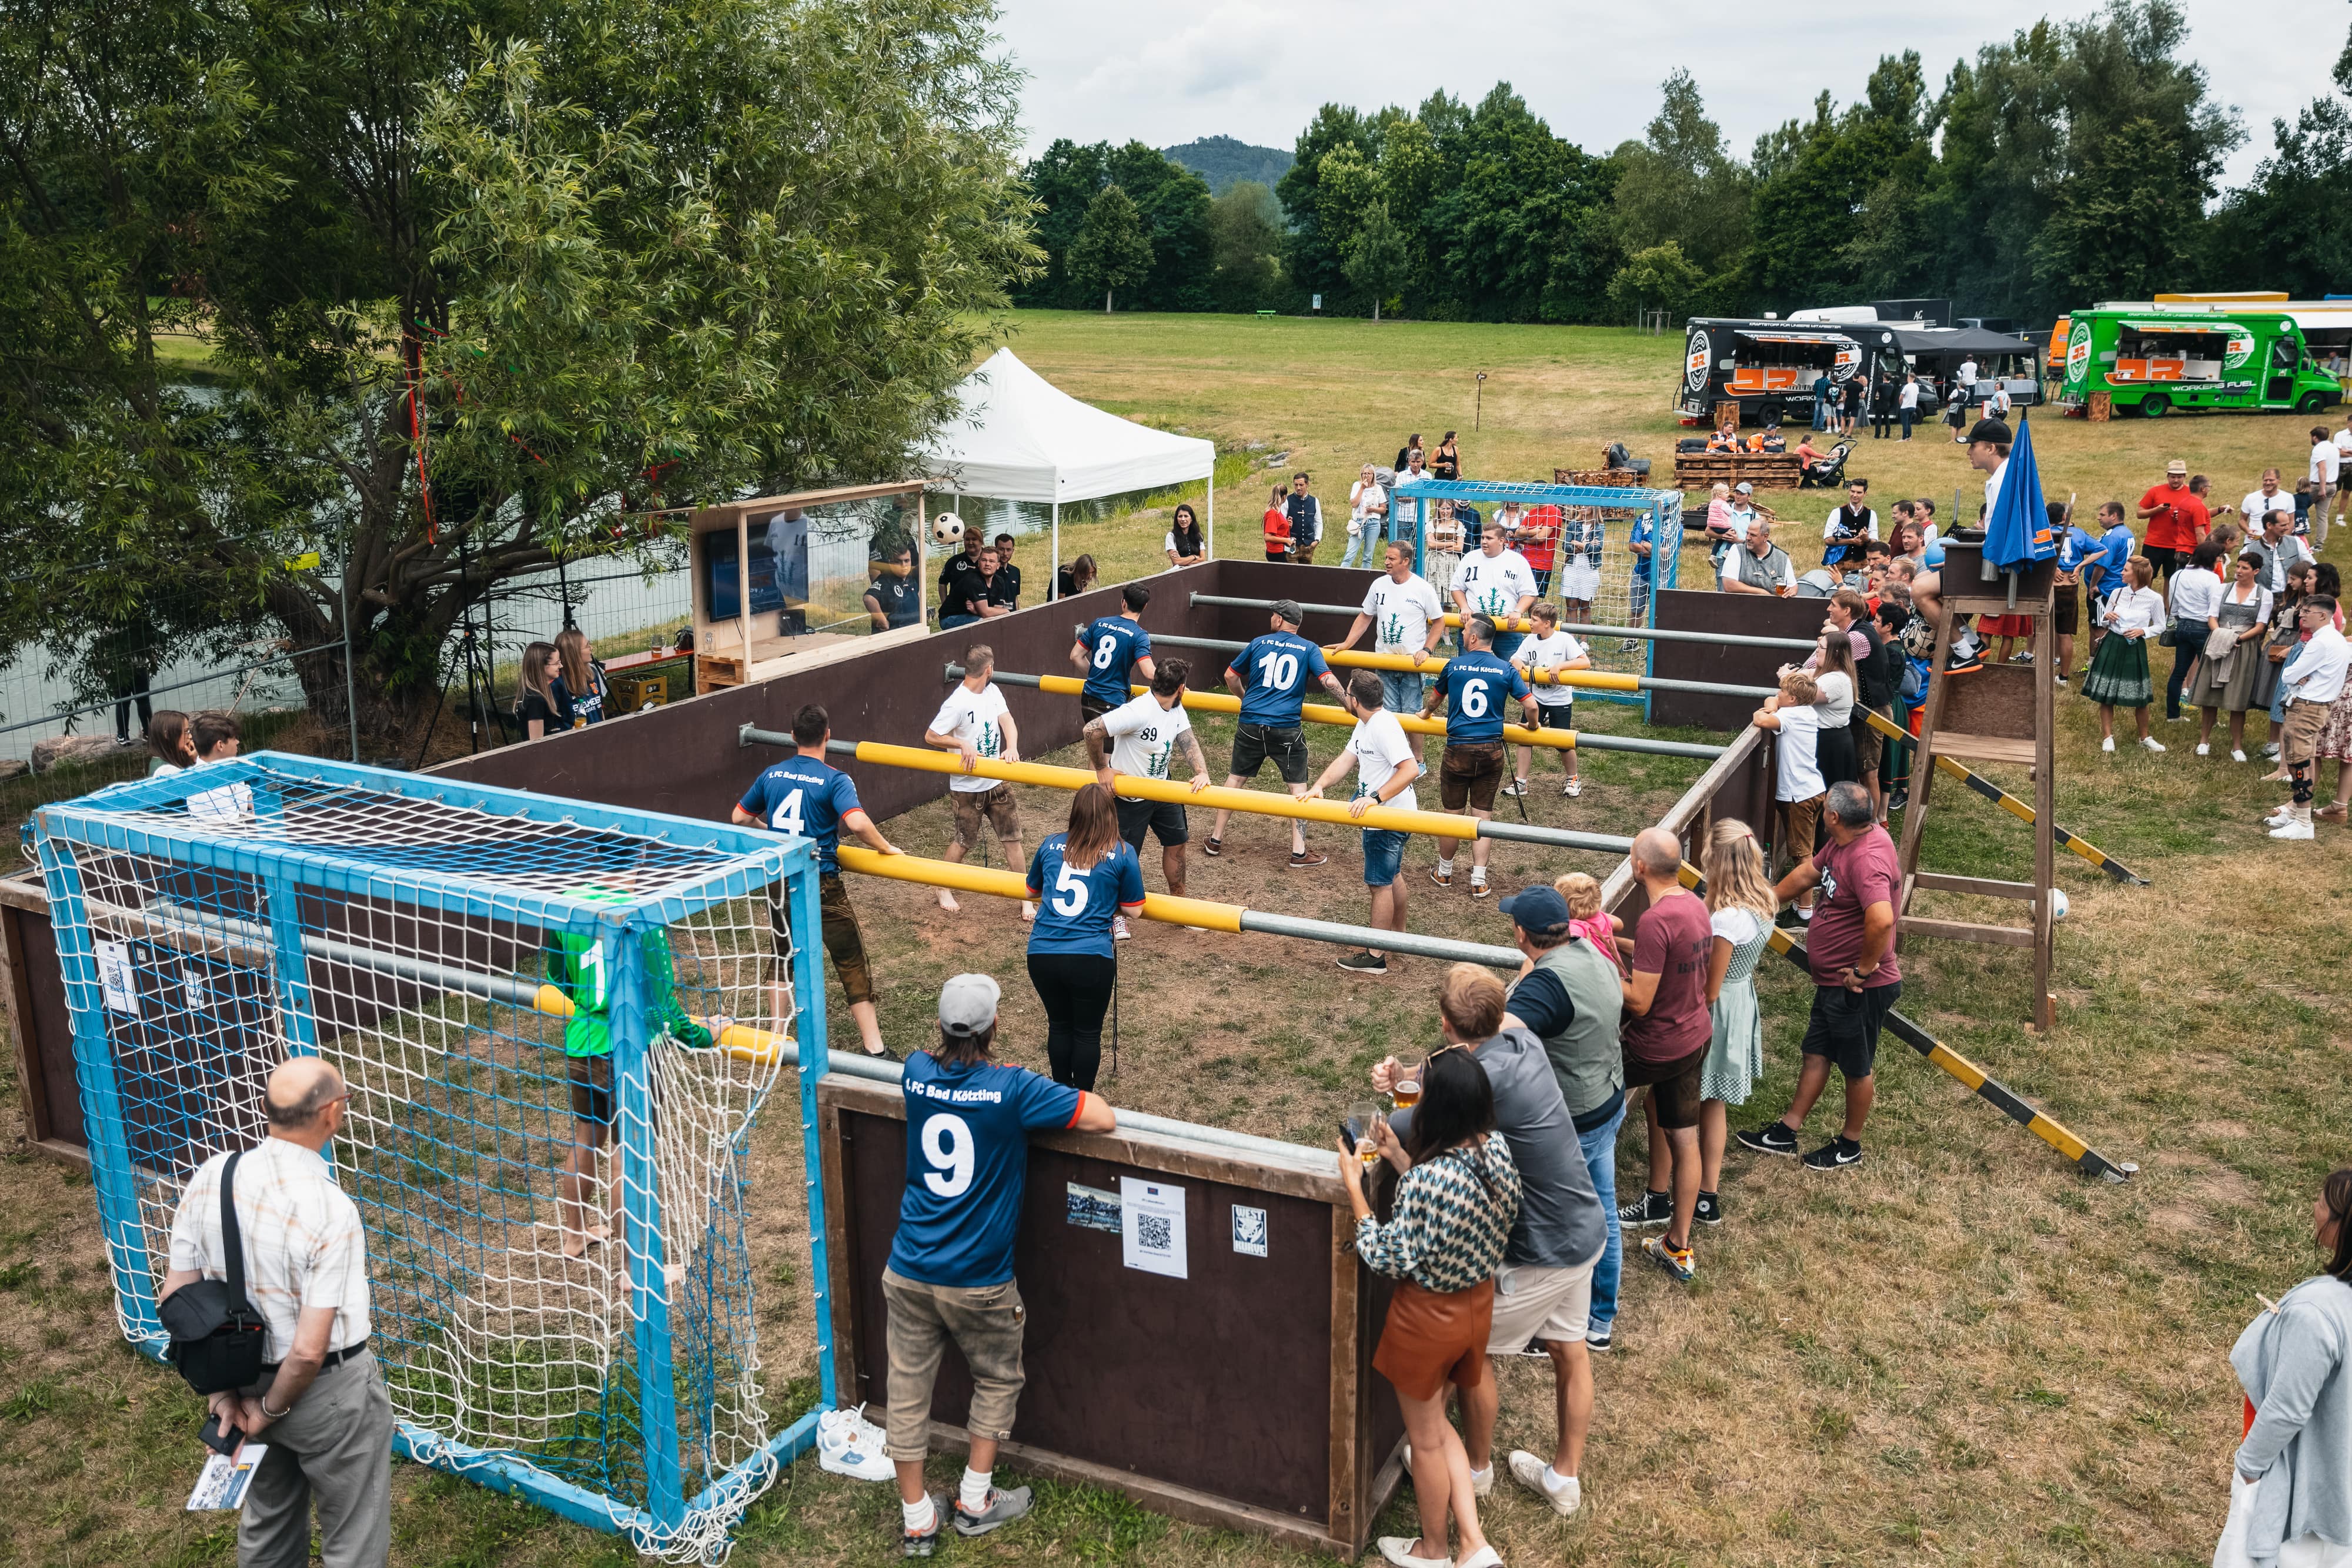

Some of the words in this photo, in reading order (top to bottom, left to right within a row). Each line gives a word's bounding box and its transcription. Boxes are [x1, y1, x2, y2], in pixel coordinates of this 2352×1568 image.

[2171, 382, 2225, 392] WORKERS
[1465, 566, 1478, 583] 21
[1375, 593, 1385, 606] 11
[1094, 635, 1117, 669] 8
[1528, 650, 1537, 661] 10
[1258, 651, 1298, 691] 10
[1480, 666, 1504, 676] Kötzting
[1462, 678, 1489, 718] 6
[967, 710, 974, 724] 7
[1140, 727, 1157, 742] 89
[783, 771, 797, 780] Bad
[772, 788, 804, 837] 4
[1056, 843, 1067, 851] FC
[1051, 860, 1091, 917] 5
[911, 1081, 925, 1095] FC
[926, 1084, 951, 1101] Bad
[951, 1088, 1002, 1104] Kötzting
[921, 1112, 975, 1198] 9
[1235, 1206, 1264, 1222] WEST
[1235, 1239, 1266, 1256] KURVE
